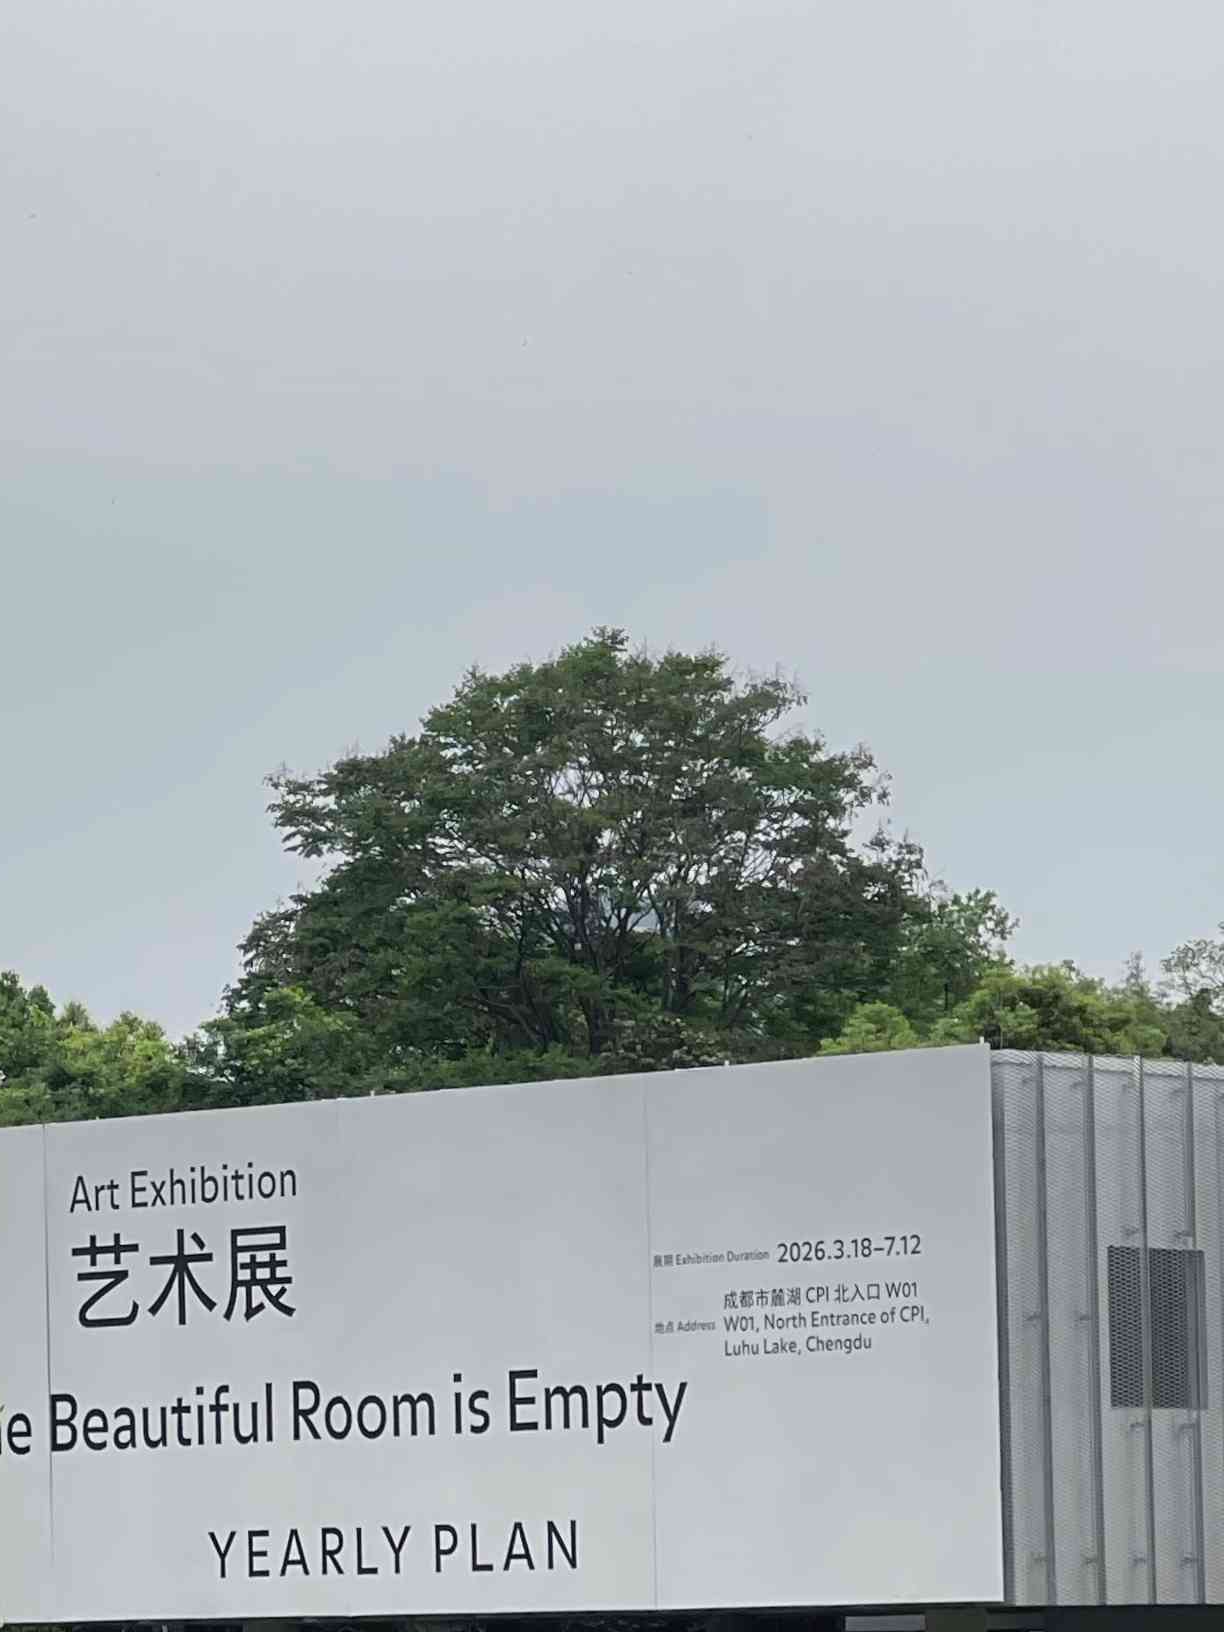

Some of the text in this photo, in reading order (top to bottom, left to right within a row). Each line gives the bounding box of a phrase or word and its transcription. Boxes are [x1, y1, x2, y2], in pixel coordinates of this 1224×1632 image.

[70, 1162, 296, 1213] Art Exhibition
[676, 1252, 725, 1265] Exhibition
[726, 1249, 770, 1263] Duration
[72, 1225, 296, 1328] 艺术展
[806, 1286, 829, 1303] CPI
[834, 1283, 880, 1304] 北入口
[885, 1282, 918, 1298] W01
[677, 1320, 716, 1332] Address
[723, 1305, 929, 1333] W01, North Entrance of CPI,
[725, 1332, 872, 1356] Luhu Lake, Chengdu
[51, 1383, 273, 1453] Beautiful
[293, 1381, 435, 1440] Room
[453, 1373, 490, 1434] is
[509, 1369, 688, 1444] Empty
[208, 1520, 577, 1578] YEARLY PLAN
